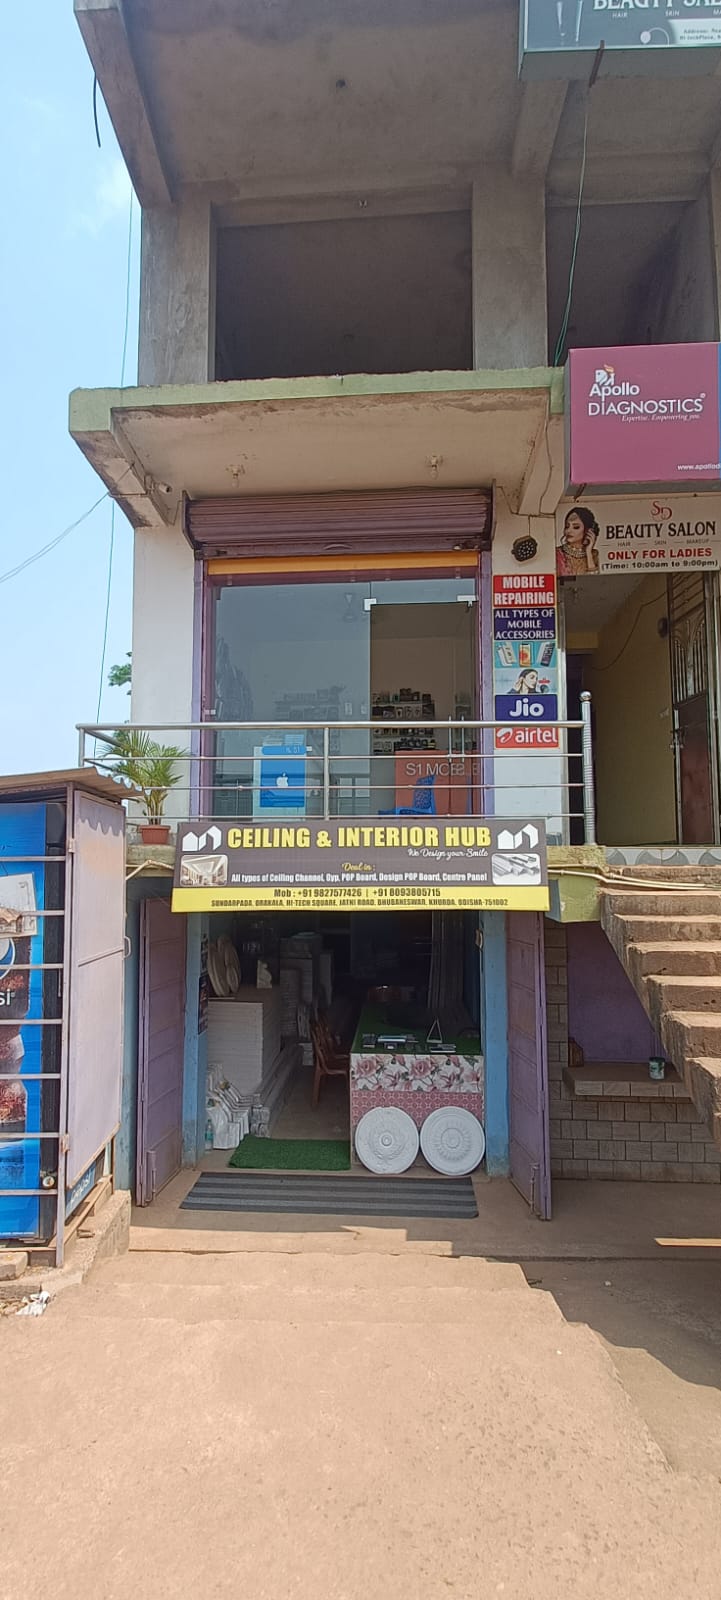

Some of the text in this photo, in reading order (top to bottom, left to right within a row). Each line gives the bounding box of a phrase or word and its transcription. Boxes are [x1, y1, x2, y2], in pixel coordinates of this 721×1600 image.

[589, 382, 640, 401] Apollo
[606, 521, 716, 539] BEAUTY SALON
[608, 548, 712, 560] ONLY FOR LADIES
[602, 562, 629, 570] (Time:
[683, 560, 718, 568] 9:00pm)
[503, 576, 544, 589] MOBILE
[494, 592, 554, 605] REPAIRING
[495, 609, 554, 618] ALL TYPES OF
[507, 620, 542, 628] MOBILE
[496, 630, 554, 639] ACCESSORIES
[510, 698, 544, 717] Jio
[515, 728, 558, 743] airtel
[228, 826, 491, 848] CEILING & INTERIOR HUB
[420, 848, 446, 860] Design
[447, 850, 465, 860] your
[465, 848, 488, 857] Smile
[232, 874, 240, 882] All
[242, 874, 260, 883] types
[262, 874, 269, 882] of
[270, 874, 294, 882] Ceiling
[342, 873, 355, 881] POP
[379, 872, 403, 882] Design
[404, 872, 418, 880] POP
[442, 872, 466, 880] Centre
[466, 872, 488, 880] Panel
[274, 888, 292, 897] Mob
[298, 888, 312, 897] +91
[314, 888, 362, 897] 9827577426
[373, 888, 388, 896] +91
